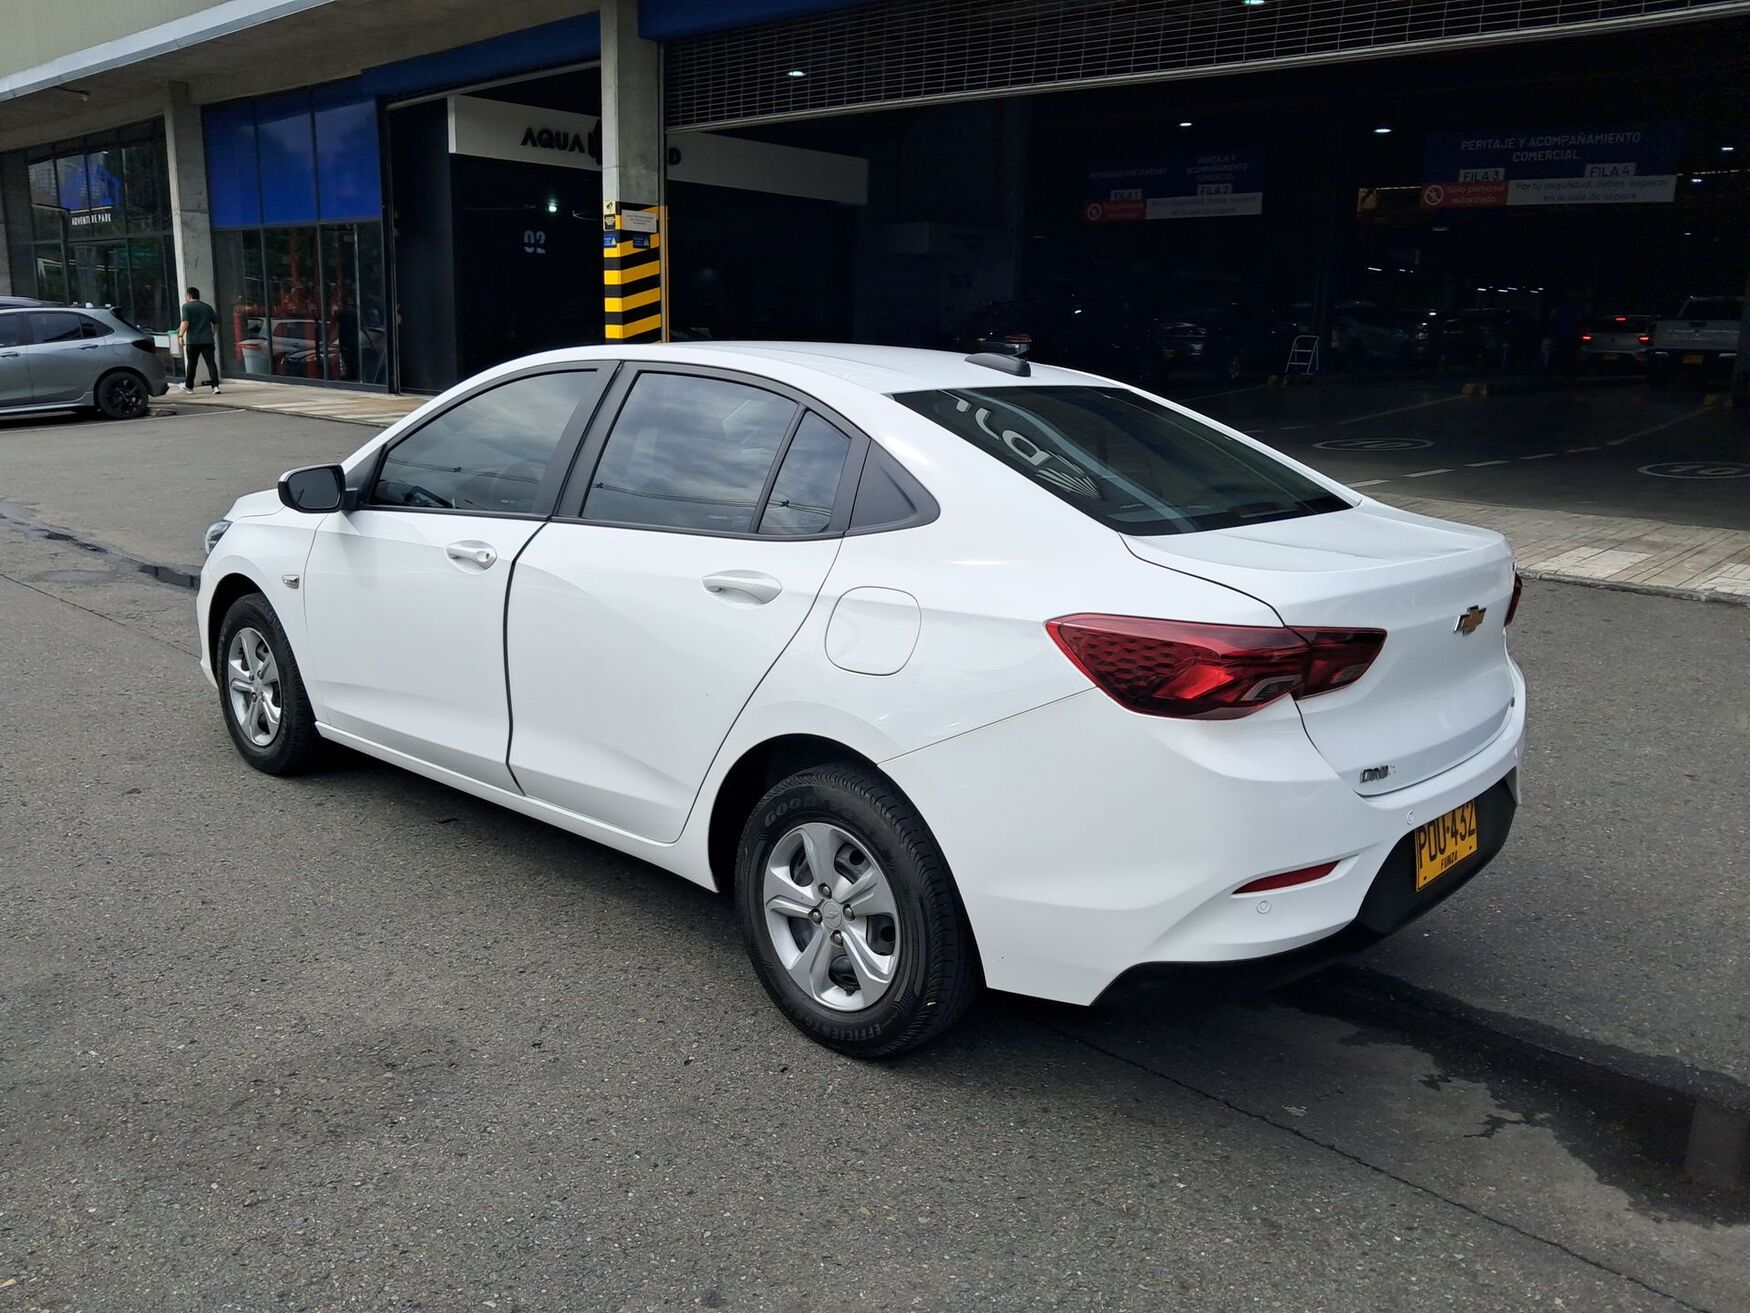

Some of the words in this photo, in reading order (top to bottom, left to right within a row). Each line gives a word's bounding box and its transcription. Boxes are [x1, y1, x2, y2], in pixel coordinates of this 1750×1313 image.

[521, 128, 585, 154] AQUA
[1461, 138, 1515, 151] PERITAJE
[1518, 137, 1526, 149] Y
[1528, 131, 1641, 147] ACOMPAÑAMIENTO
[1512, 149, 1579, 162] COMERCIAL
[1464, 171, 1488, 181] FILA
[1590, 167, 1617, 177] FILA
[1623, 165, 1633, 175] 4
[523, 229, 547, 254] 02
